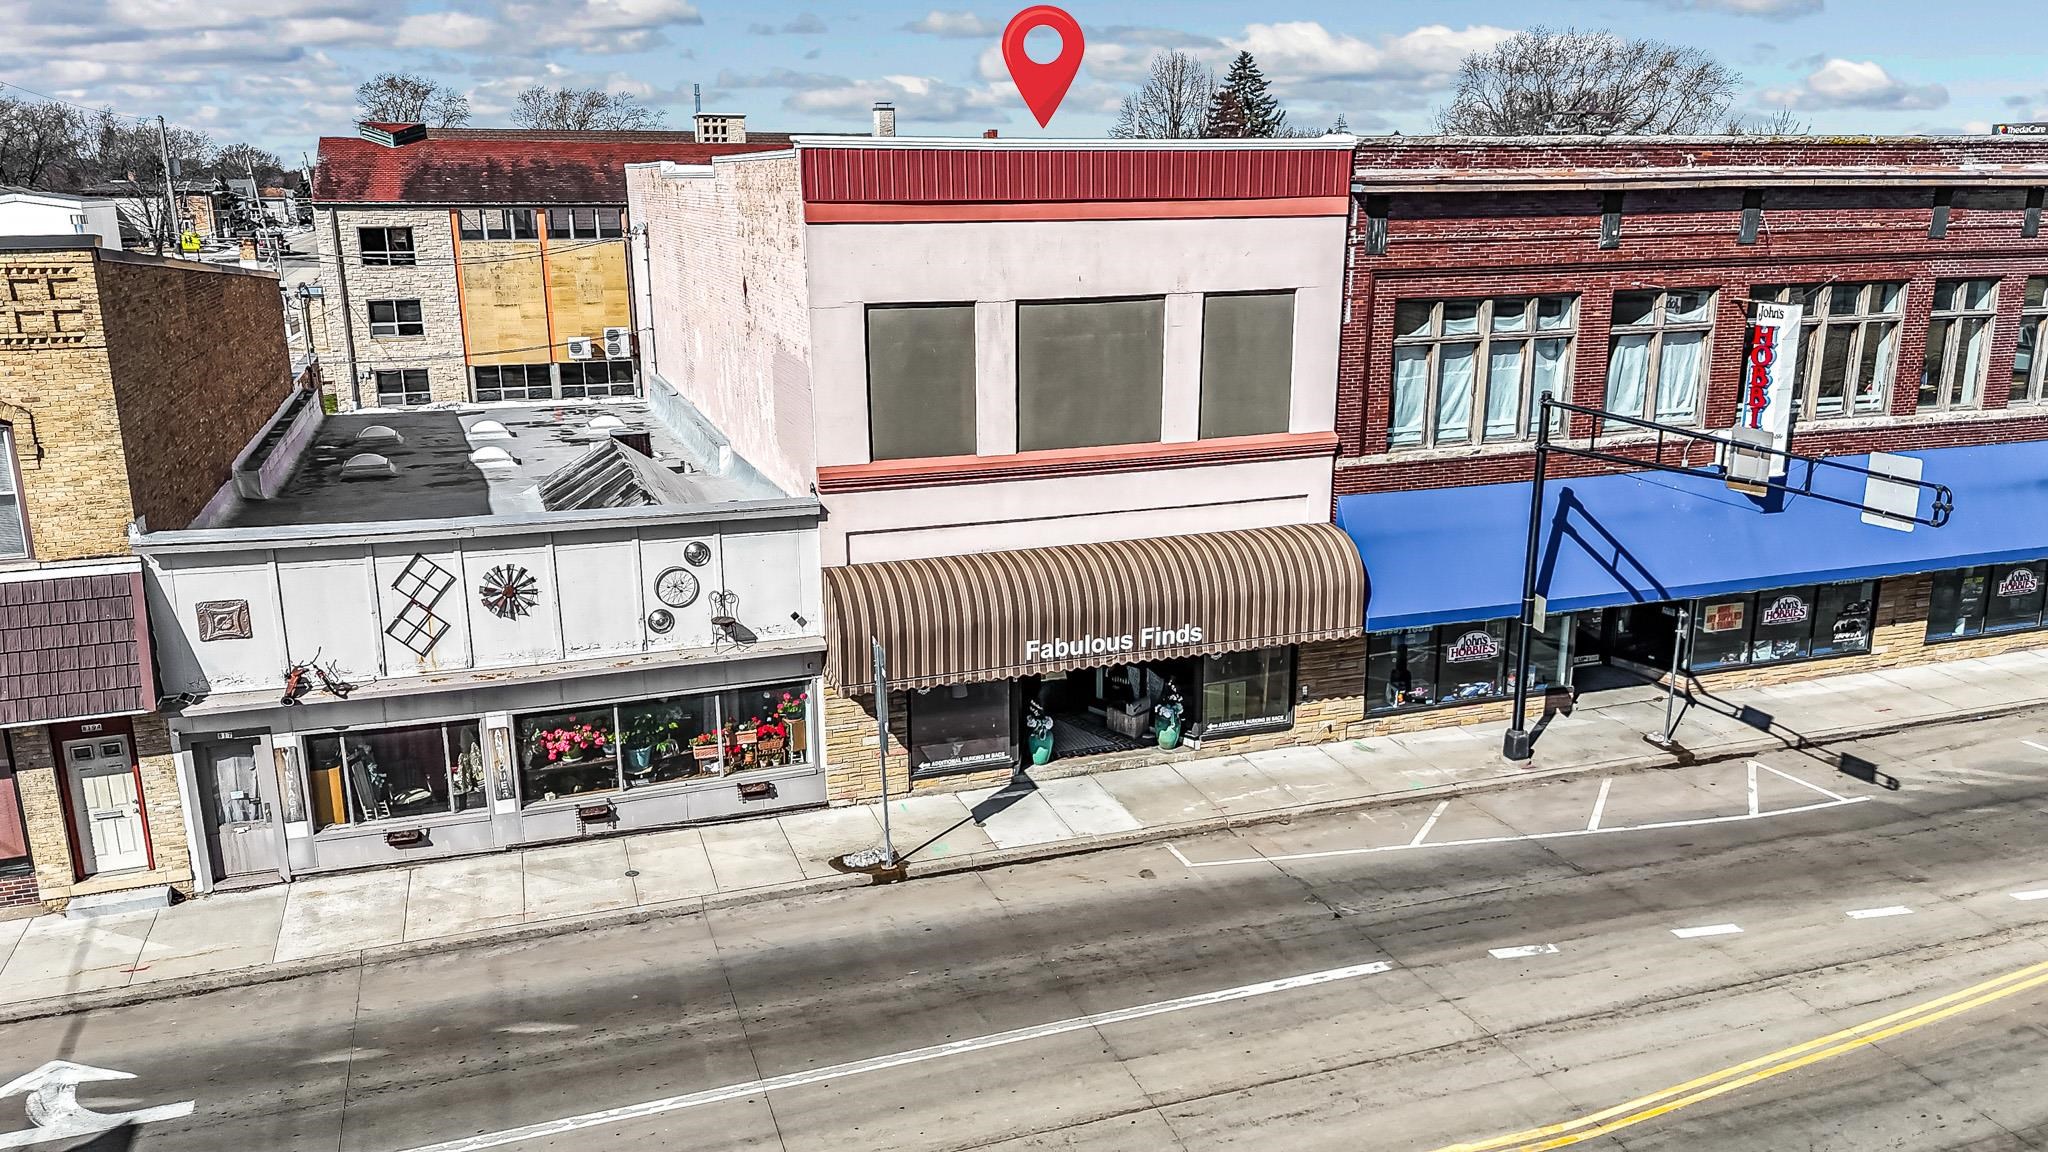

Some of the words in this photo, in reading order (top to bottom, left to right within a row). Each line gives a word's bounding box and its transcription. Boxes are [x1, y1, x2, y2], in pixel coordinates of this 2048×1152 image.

[2007, 125, 2047, 134] ThedaCare
[1759, 305, 1784, 320] John's
[1748, 325, 1778, 429] HOBBI
[2001, 580, 2036, 592] HOBBIES
[1766, 608, 1805, 620] HOBBIES
[1026, 634, 1133, 661] Fabulous
[1140, 624, 1203, 648] Finds
[1461, 634, 1488, 649] John's
[1450, 643, 1496, 658] HOBBIES
[931, 757, 961, 767] ADDITIONAL
[281, 747, 297, 821] VINTAGE
